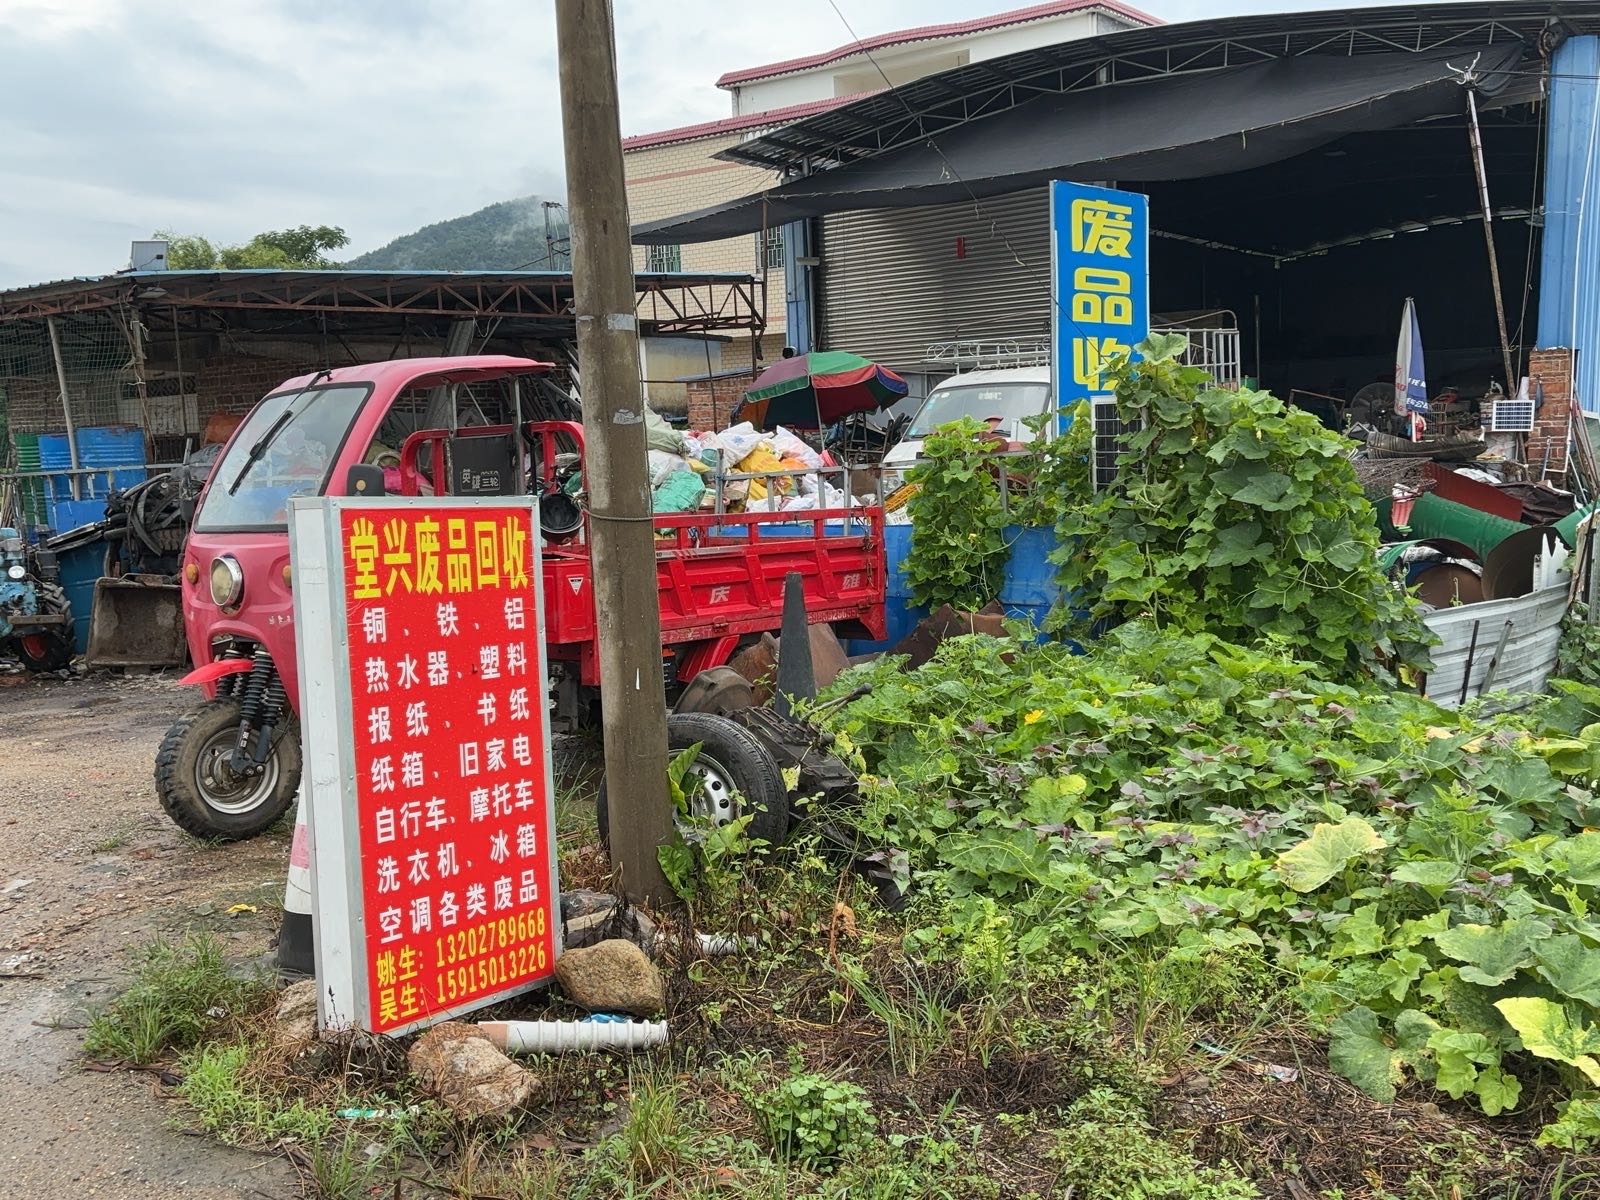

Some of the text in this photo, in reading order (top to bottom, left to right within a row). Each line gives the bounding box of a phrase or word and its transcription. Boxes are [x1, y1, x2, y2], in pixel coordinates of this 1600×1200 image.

[350, 515, 528, 599] 堂兴废品回收
[379, 869, 538, 944] 空调各类废品
